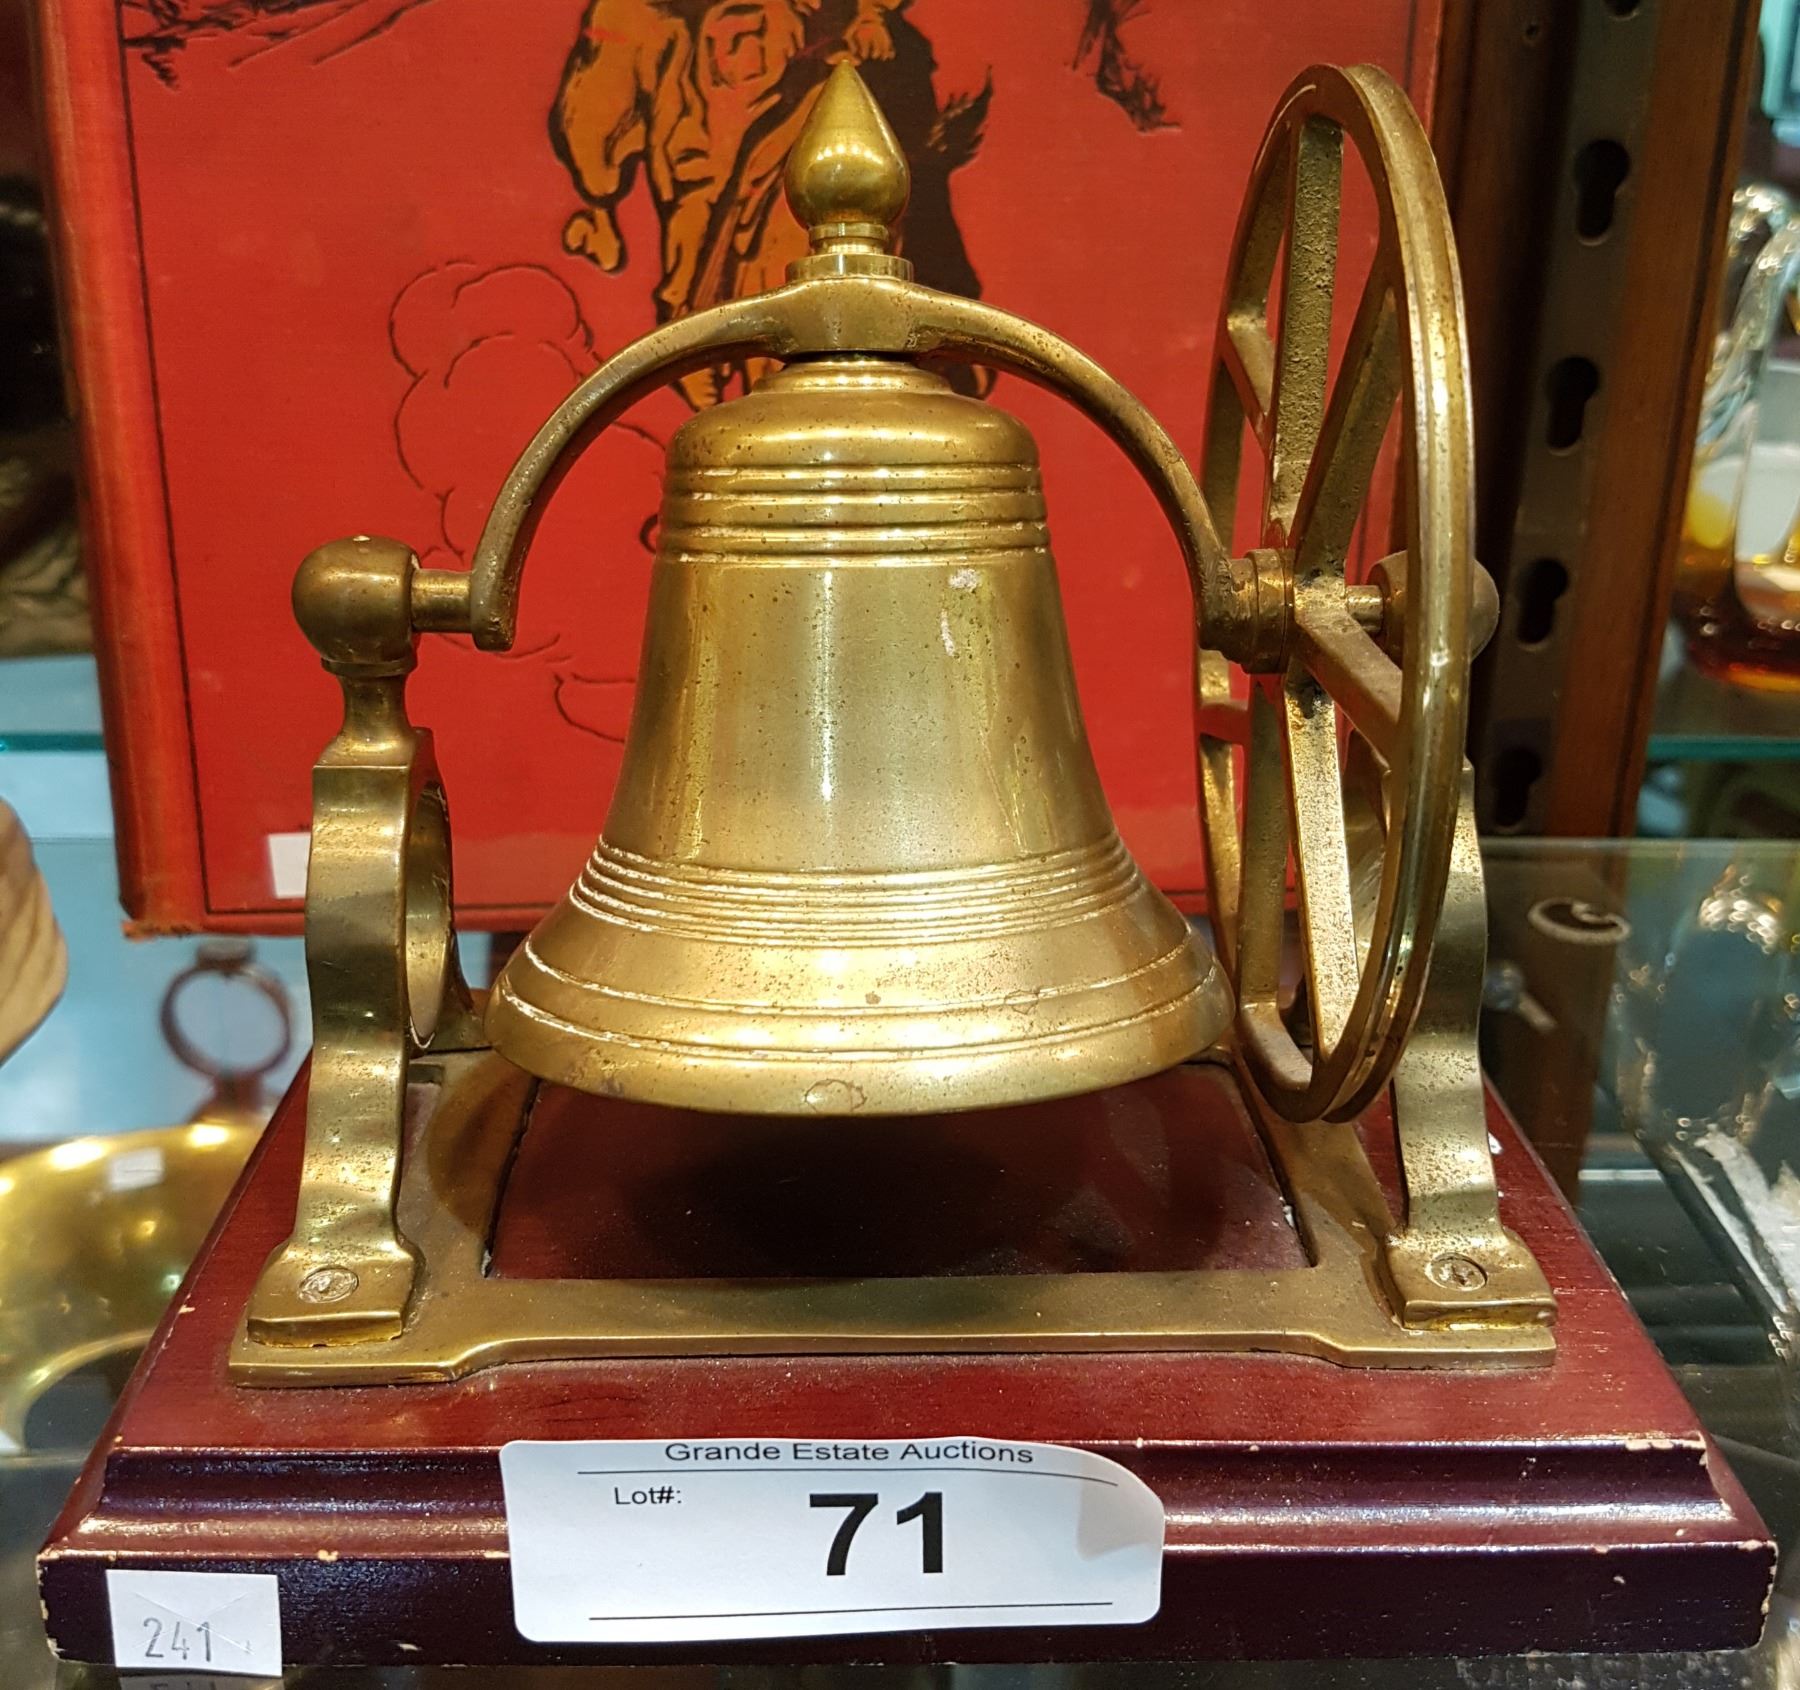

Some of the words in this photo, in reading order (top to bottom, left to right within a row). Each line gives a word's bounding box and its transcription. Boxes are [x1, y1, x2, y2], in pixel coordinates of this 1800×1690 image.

[664, 1442, 781, 1462] Grande
[792, 1442, 890, 1461] Estate
[899, 1440, 1034, 1463] Auctions
[614, 1485, 682, 1505] Lot#:
[809, 1491, 943, 1576] 71
[143, 1617, 212, 1662] 241
